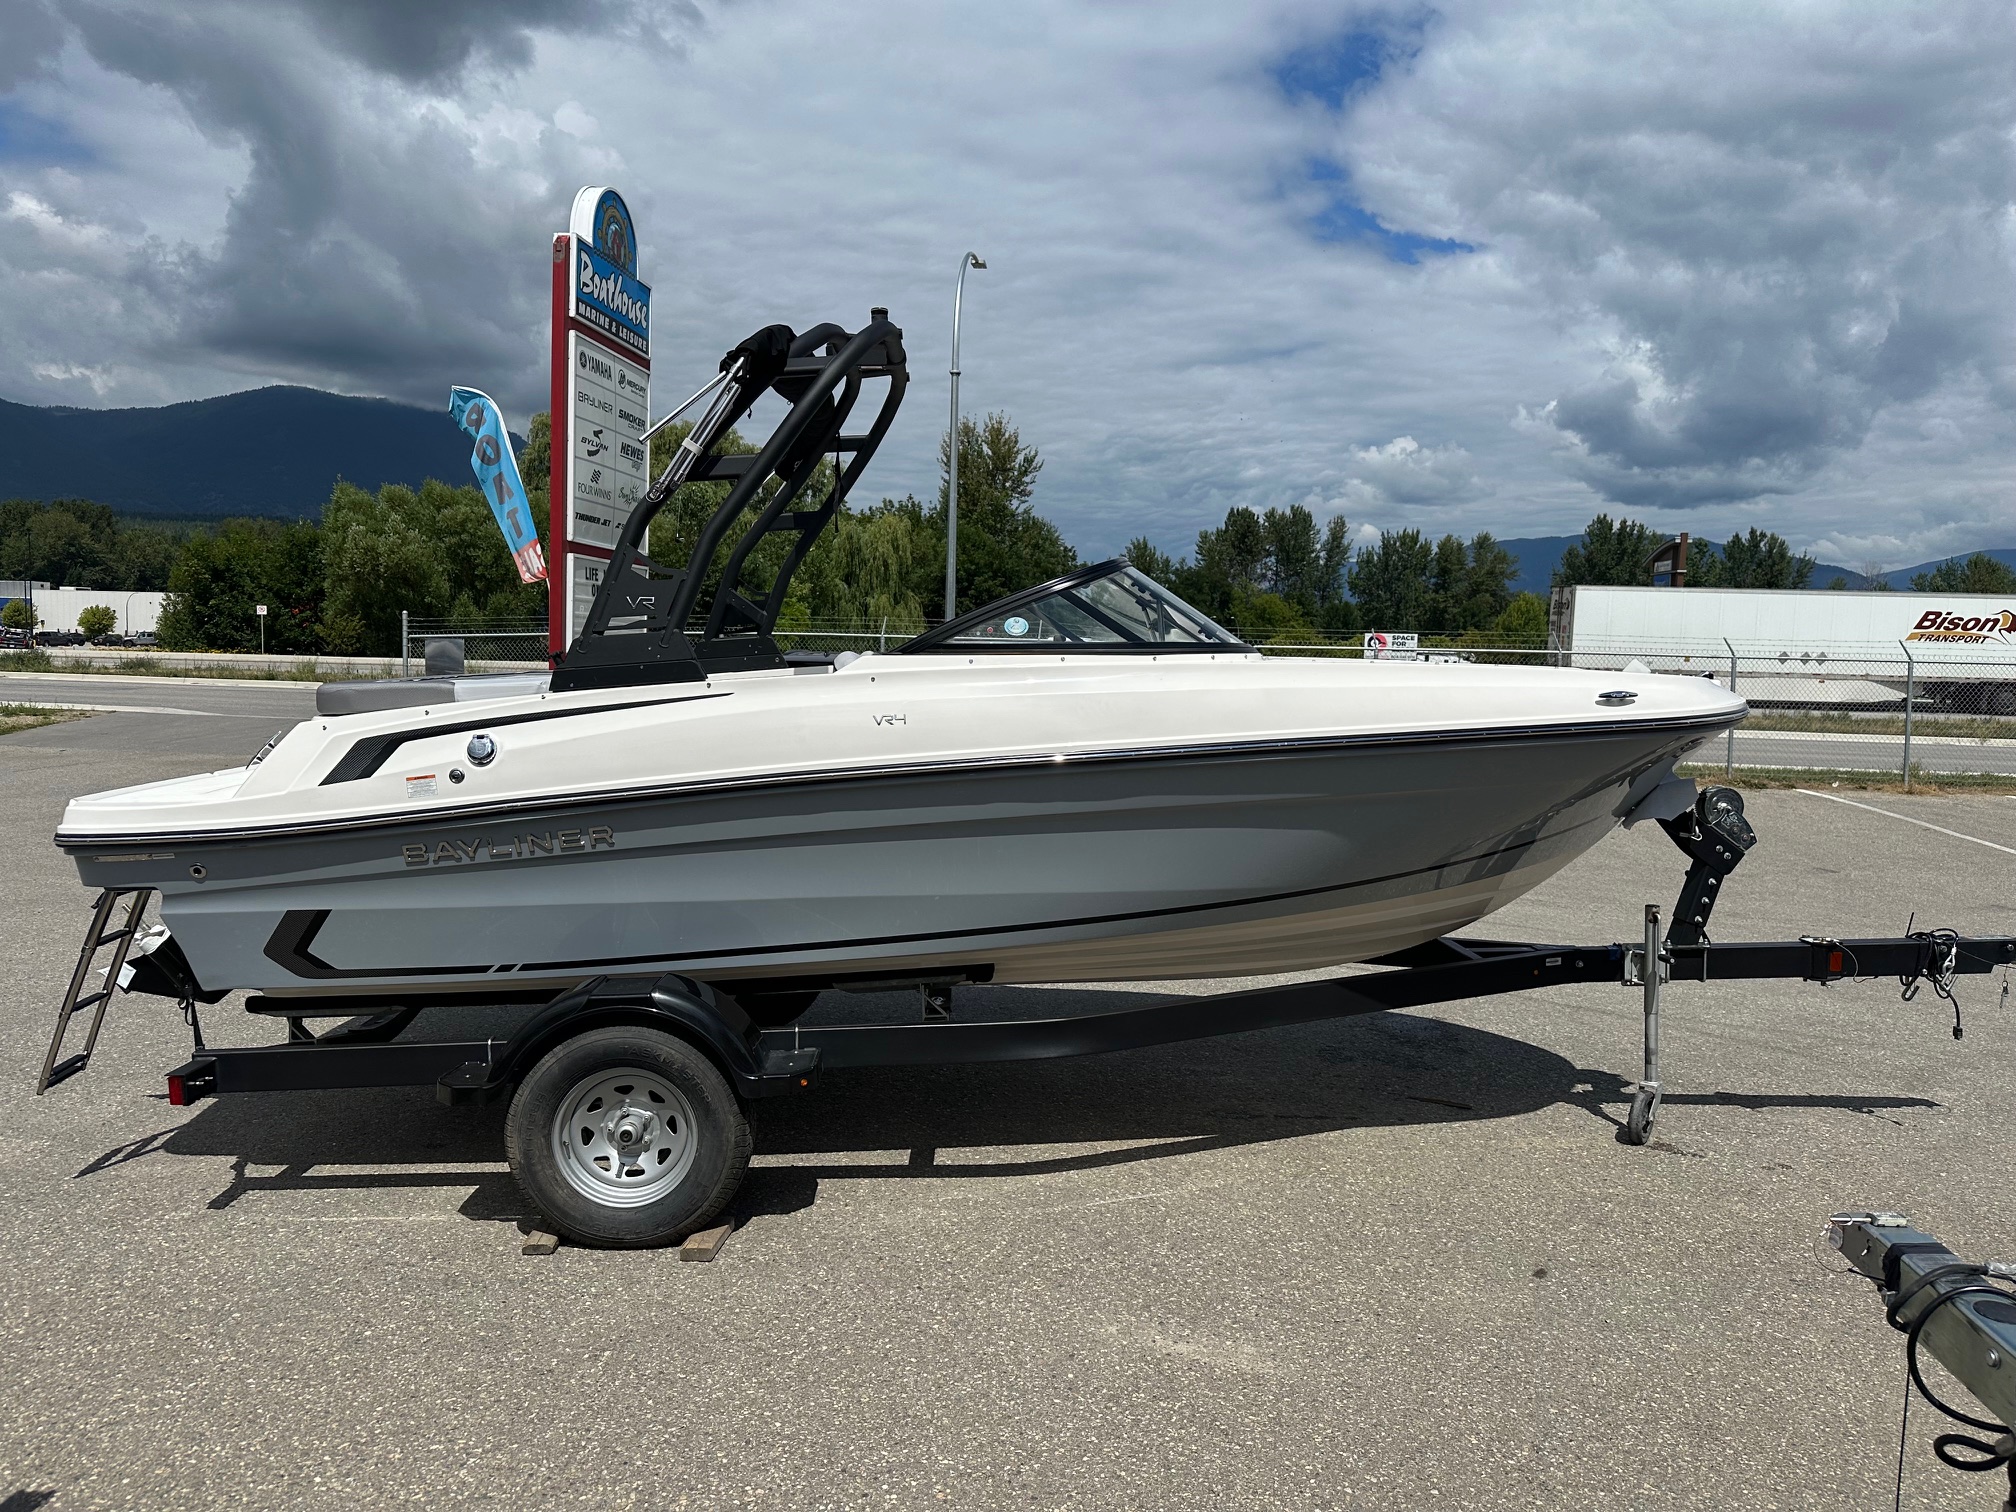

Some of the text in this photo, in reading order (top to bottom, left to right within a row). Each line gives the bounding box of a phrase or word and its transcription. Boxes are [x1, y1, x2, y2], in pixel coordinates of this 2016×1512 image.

[579, 250, 648, 329] Boathouse
[578, 301, 647, 352] MARINE & LEISURE
[587, 354, 613, 382] YAMAHA
[577, 391, 613, 415] BAYLINER
[618, 408, 646, 431] SMOKER
[580, 436, 609, 452] SYLVAN
[620, 441, 645, 462] HEWES
[574, 511, 601, 525] THUNDER
[601, 518, 612, 527] JET
[585, 566, 599, 582] LIFE
[626, 596, 655, 610] VR
[1913, 611, 2001, 632] Bison
[1917, 634, 1991, 645] TRANSPORT
[402, 825, 616, 866] BAYLINER
